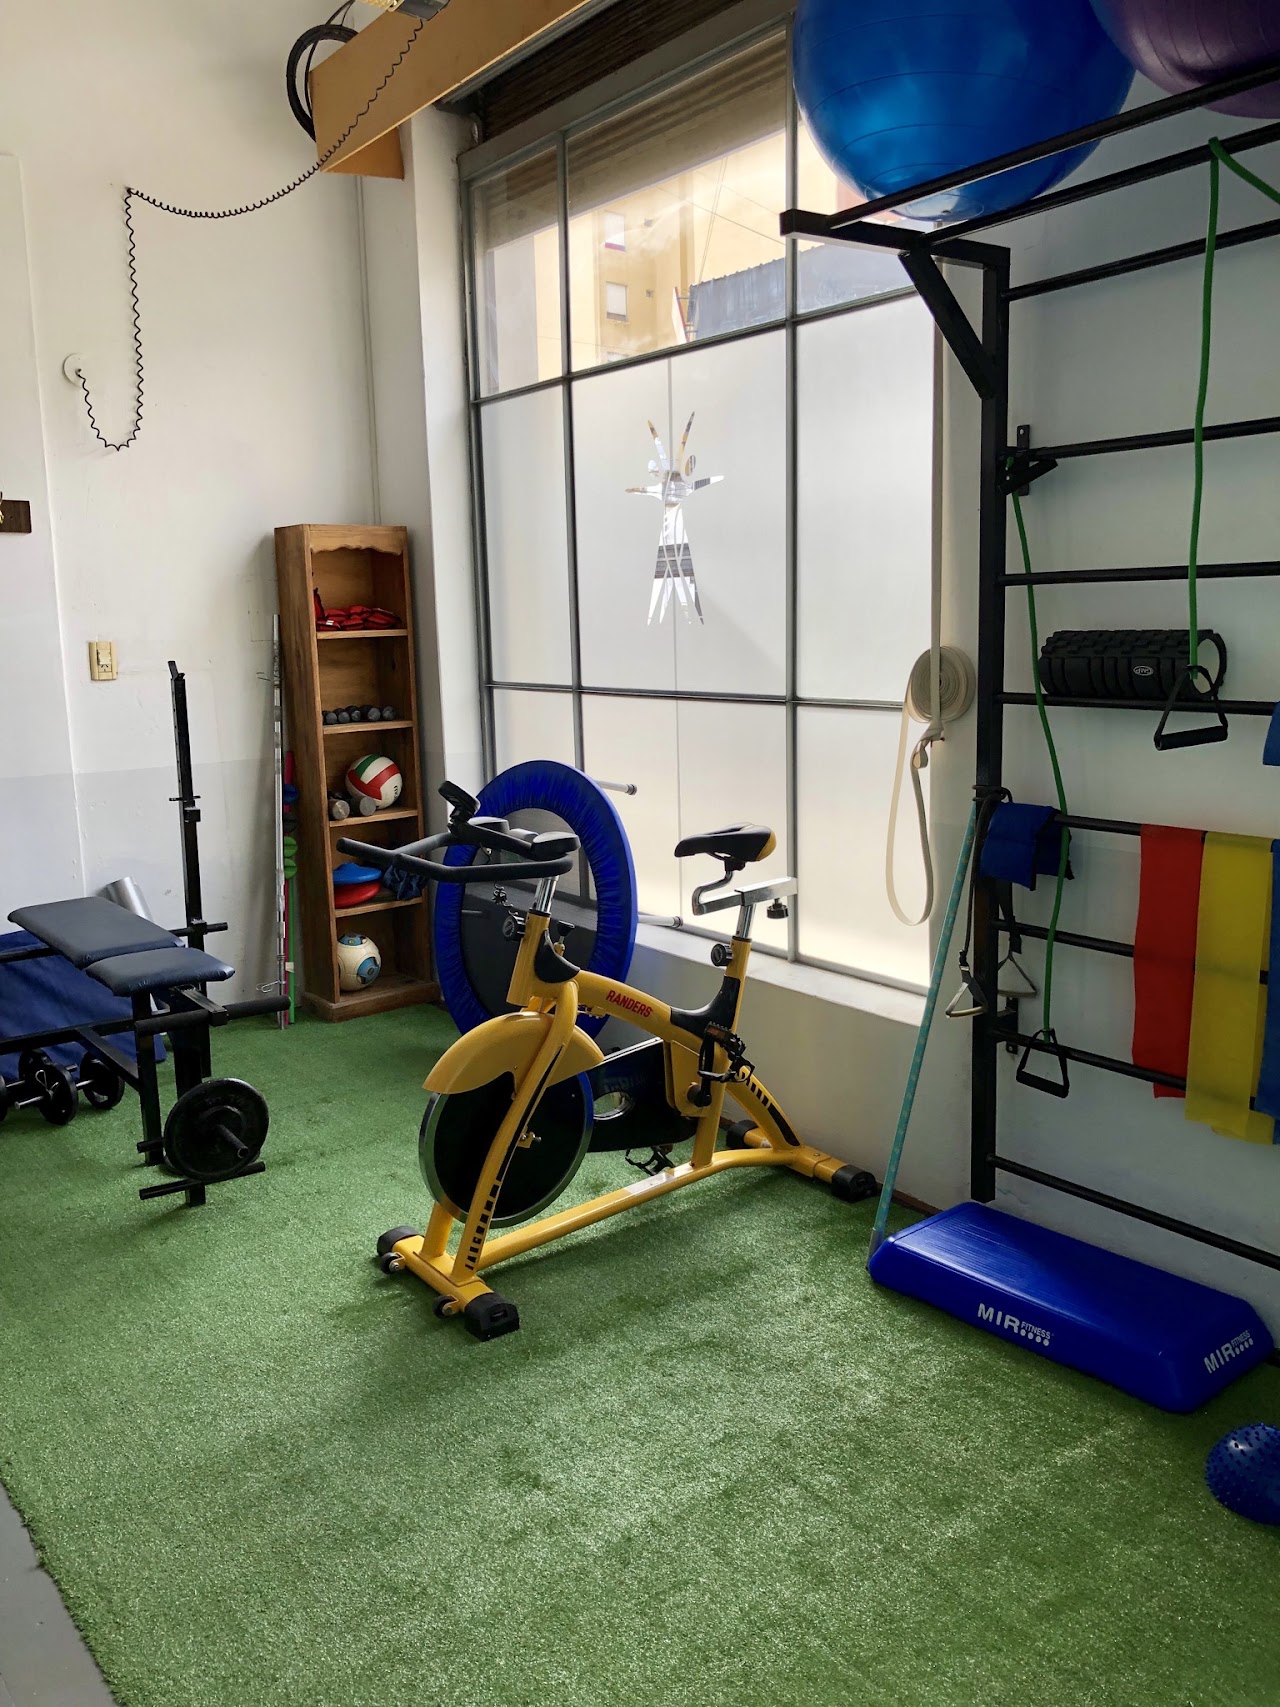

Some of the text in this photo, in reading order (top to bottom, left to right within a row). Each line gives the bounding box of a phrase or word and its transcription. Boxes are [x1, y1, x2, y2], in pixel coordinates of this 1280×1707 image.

[606, 990, 653, 1017] RANDERS
[977, 1303, 1051, 1340] MIR FITNESS
[1204, 1343, 1236, 1373] MIR
